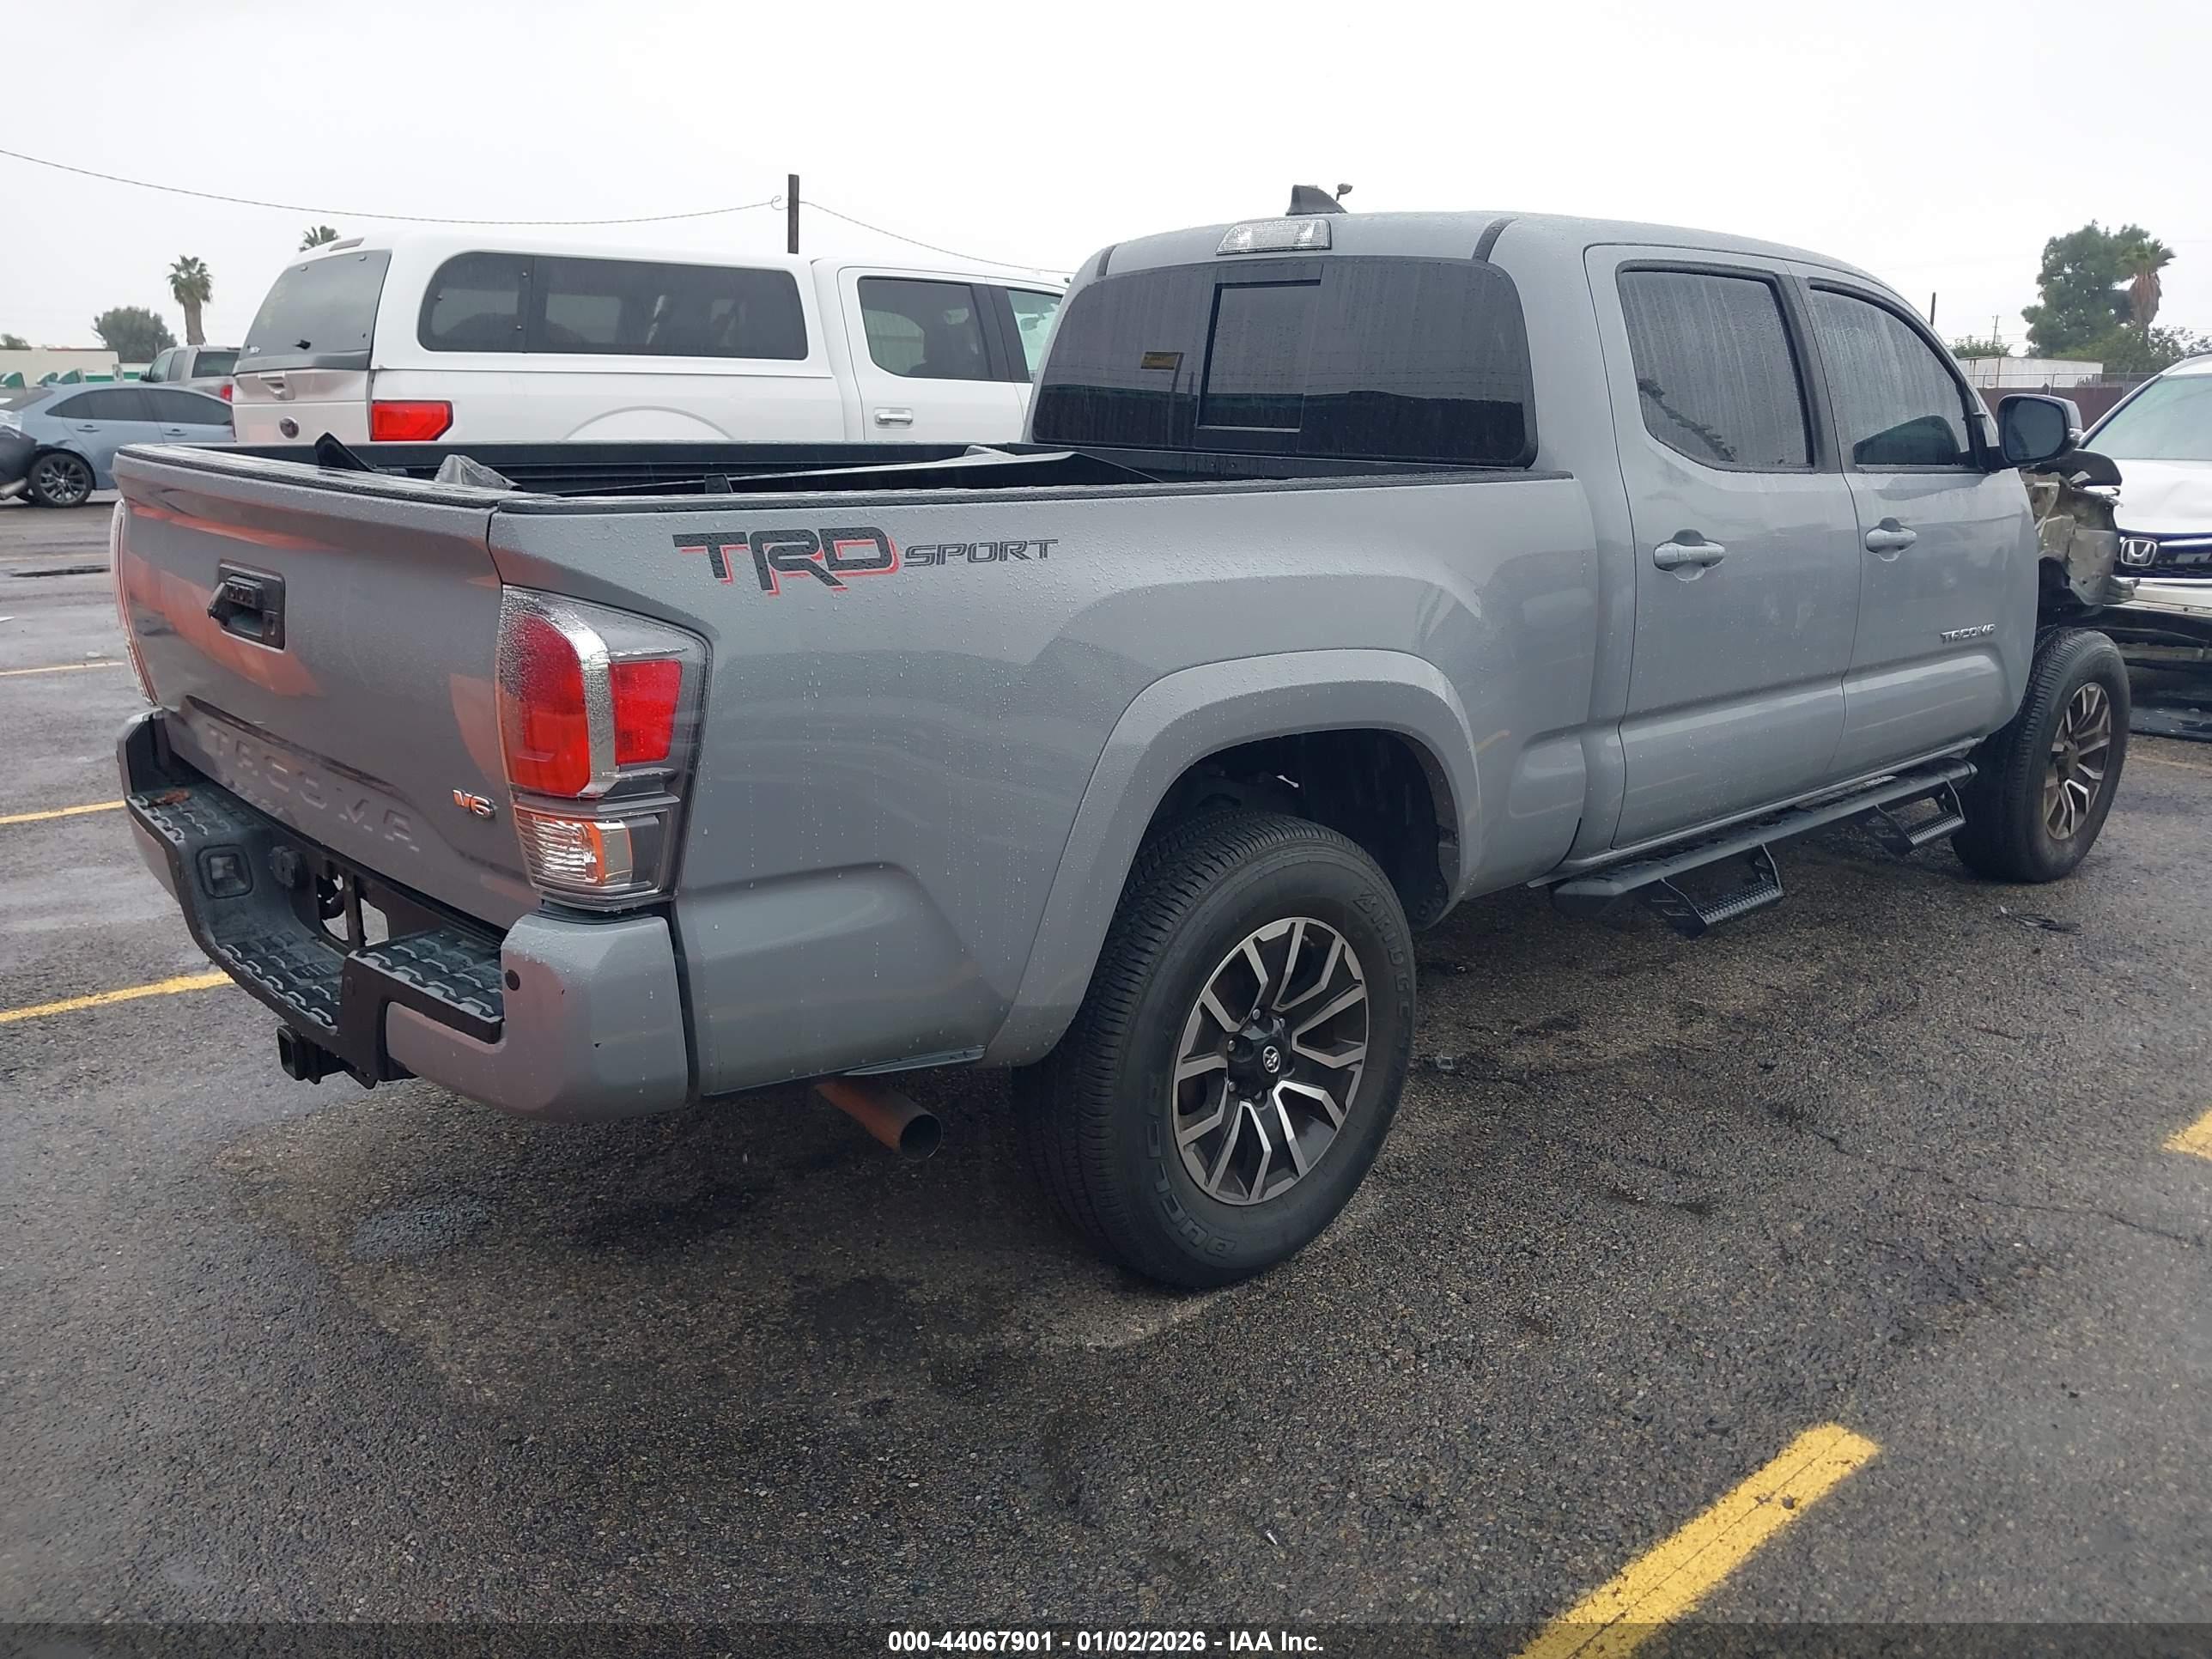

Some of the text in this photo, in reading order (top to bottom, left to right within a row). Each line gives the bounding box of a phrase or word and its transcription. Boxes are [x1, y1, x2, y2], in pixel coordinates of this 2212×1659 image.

[672, 526, 1059, 595] TRD SPORT
[206, 721, 421, 853] TACOMA
[453, 787, 499, 820] V6
